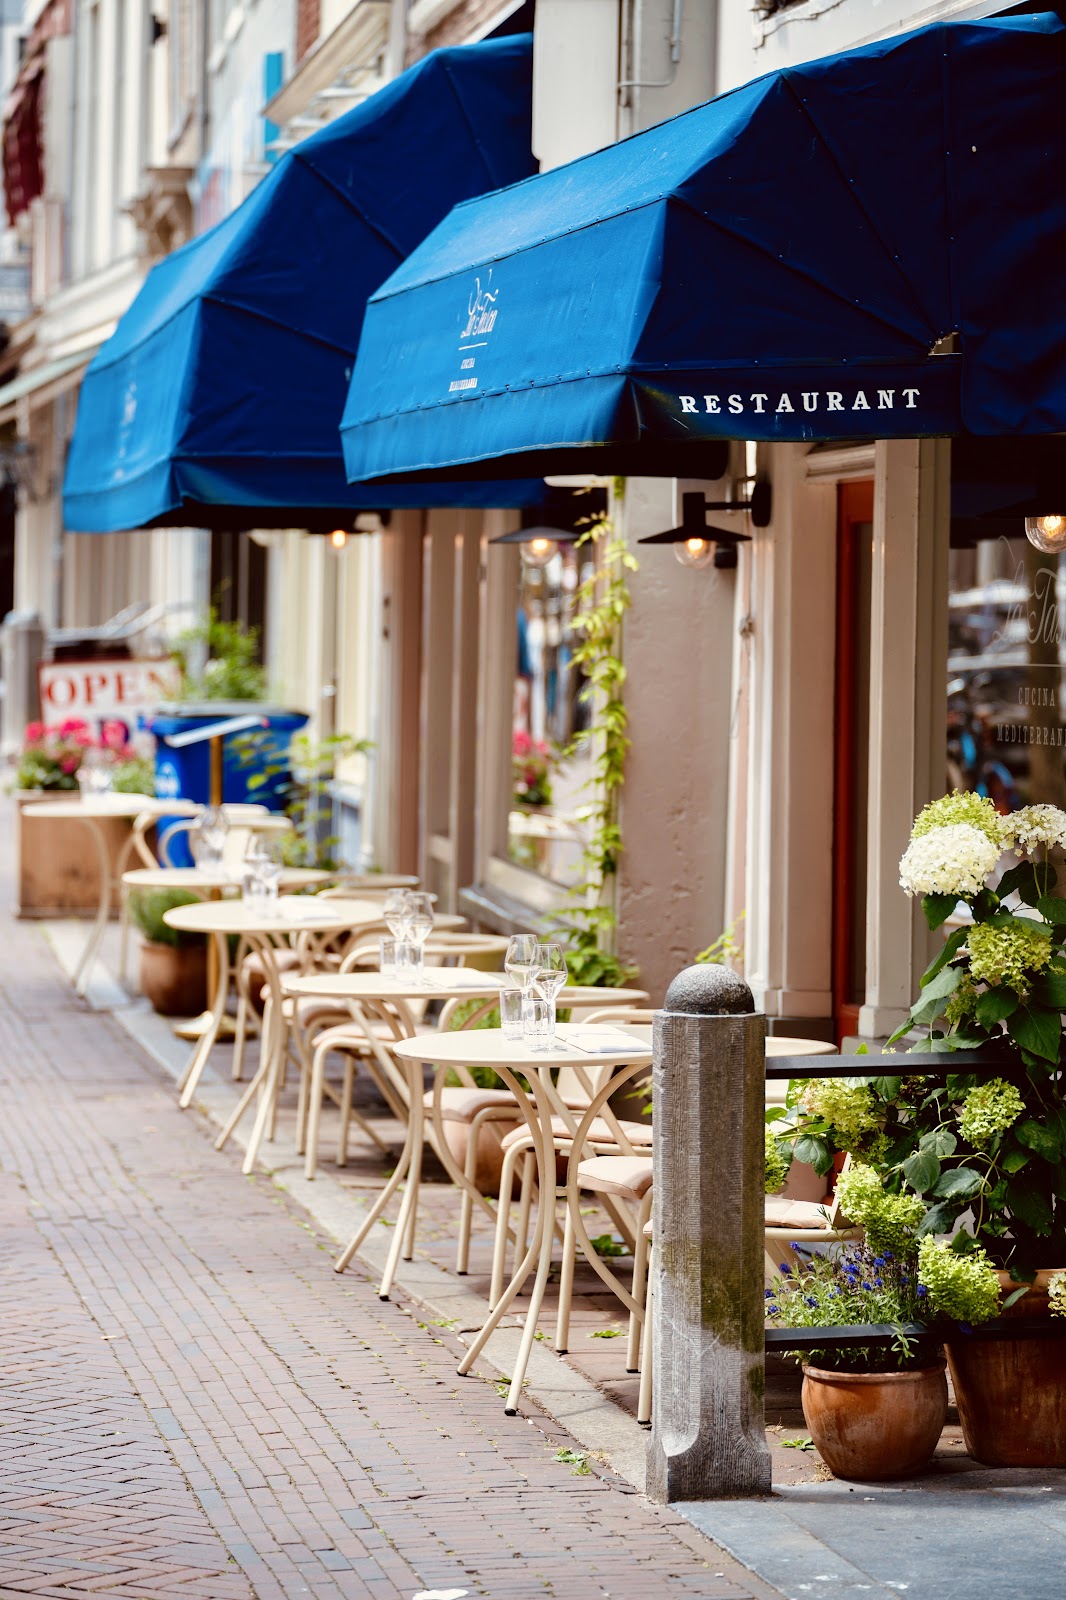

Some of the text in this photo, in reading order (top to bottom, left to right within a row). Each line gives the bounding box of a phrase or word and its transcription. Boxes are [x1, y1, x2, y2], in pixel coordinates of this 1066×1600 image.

[679, 388, 921, 415] RESTAURANT
[46, 671, 178, 706] OPEN
[1018, 686, 1056, 707] CUCINA
